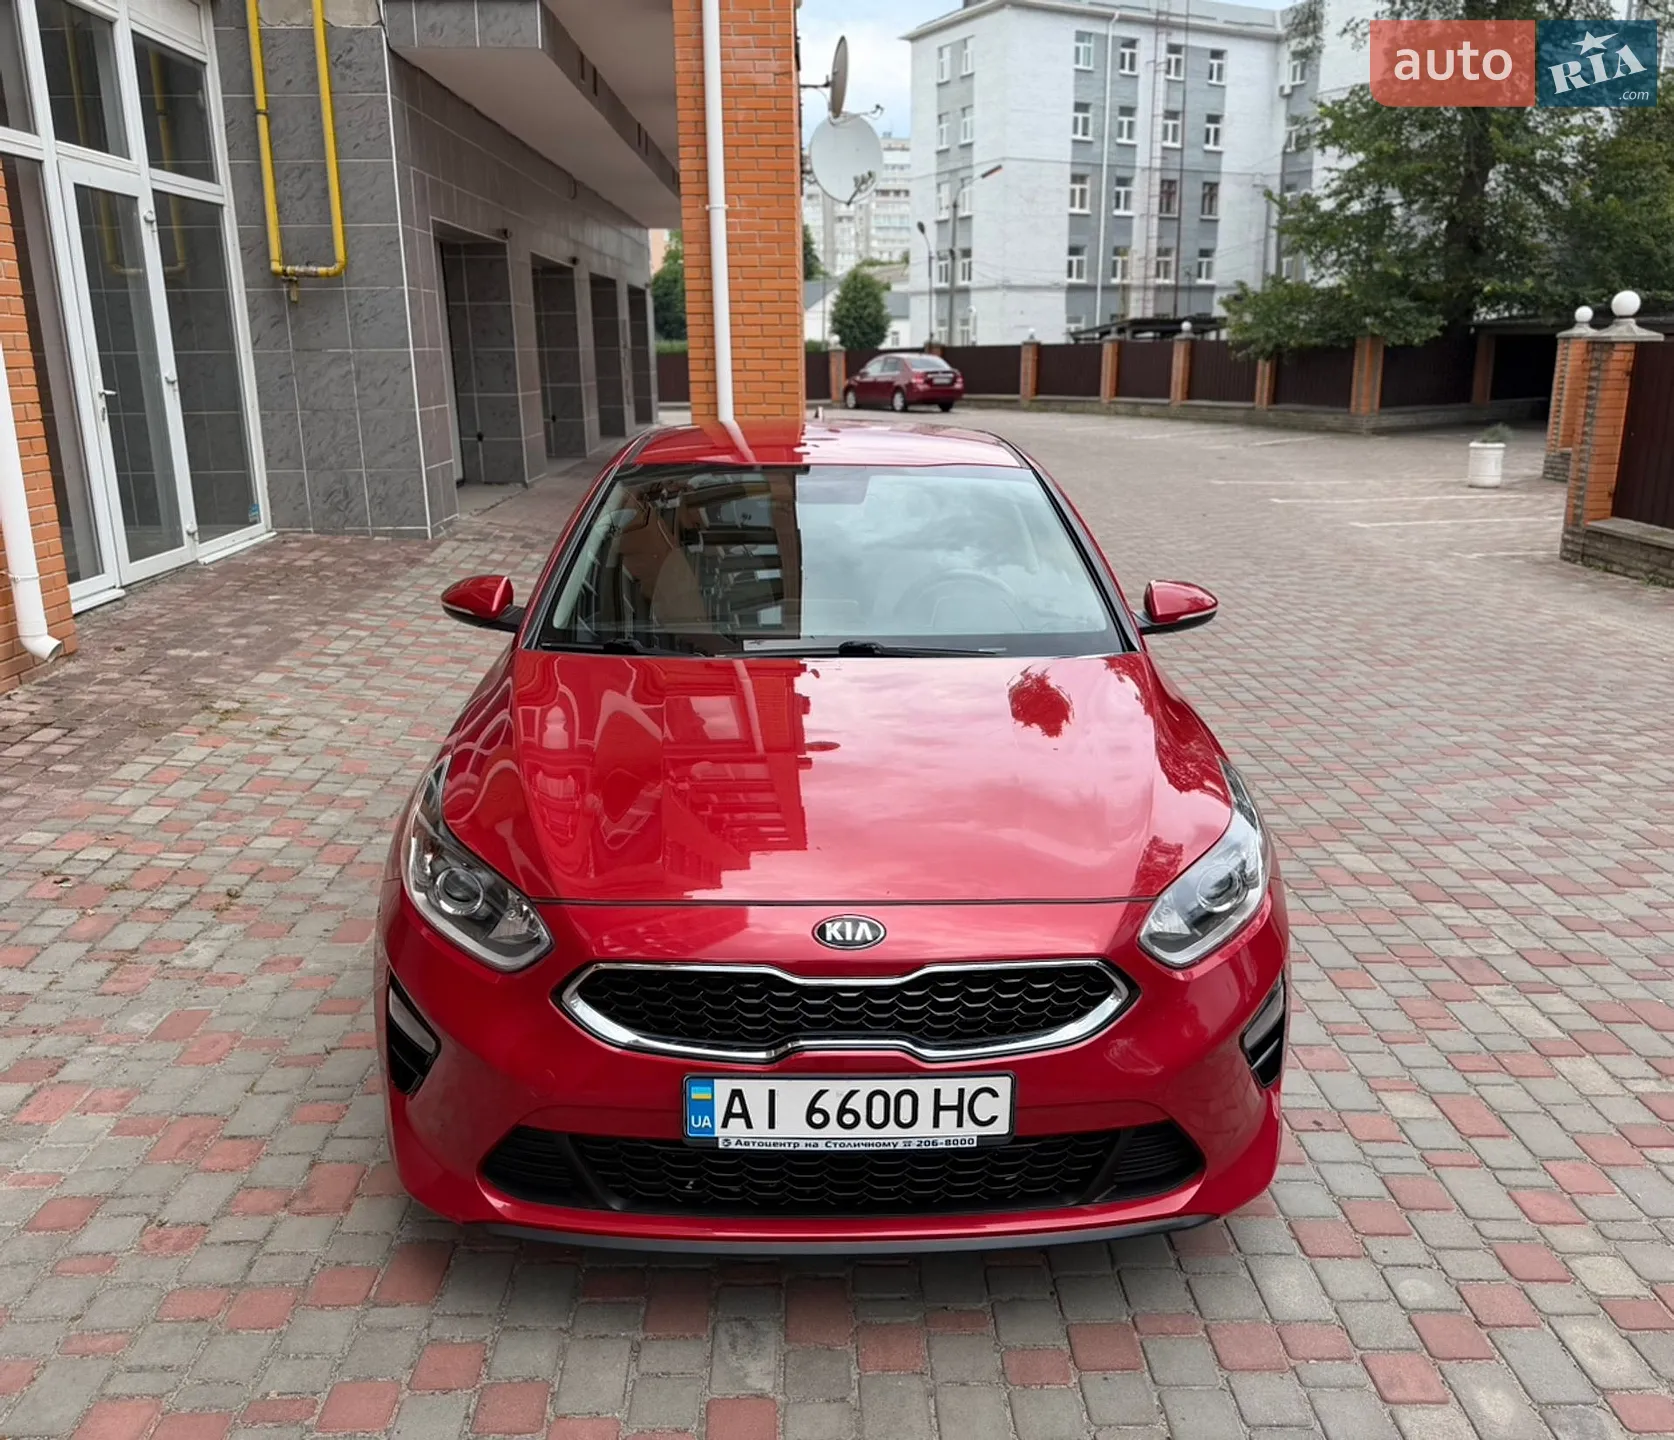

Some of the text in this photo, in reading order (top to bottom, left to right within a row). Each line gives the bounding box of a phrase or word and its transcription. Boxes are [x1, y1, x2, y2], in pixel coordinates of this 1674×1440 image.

[825, 921, 873, 941] KIA
[691, 1115, 712, 1129] UA
[734, 1139, 800, 1149] Автоцентр
[824, 1140, 899, 1149] Столичному
[915, 1137, 975, 1148] 206-8000
